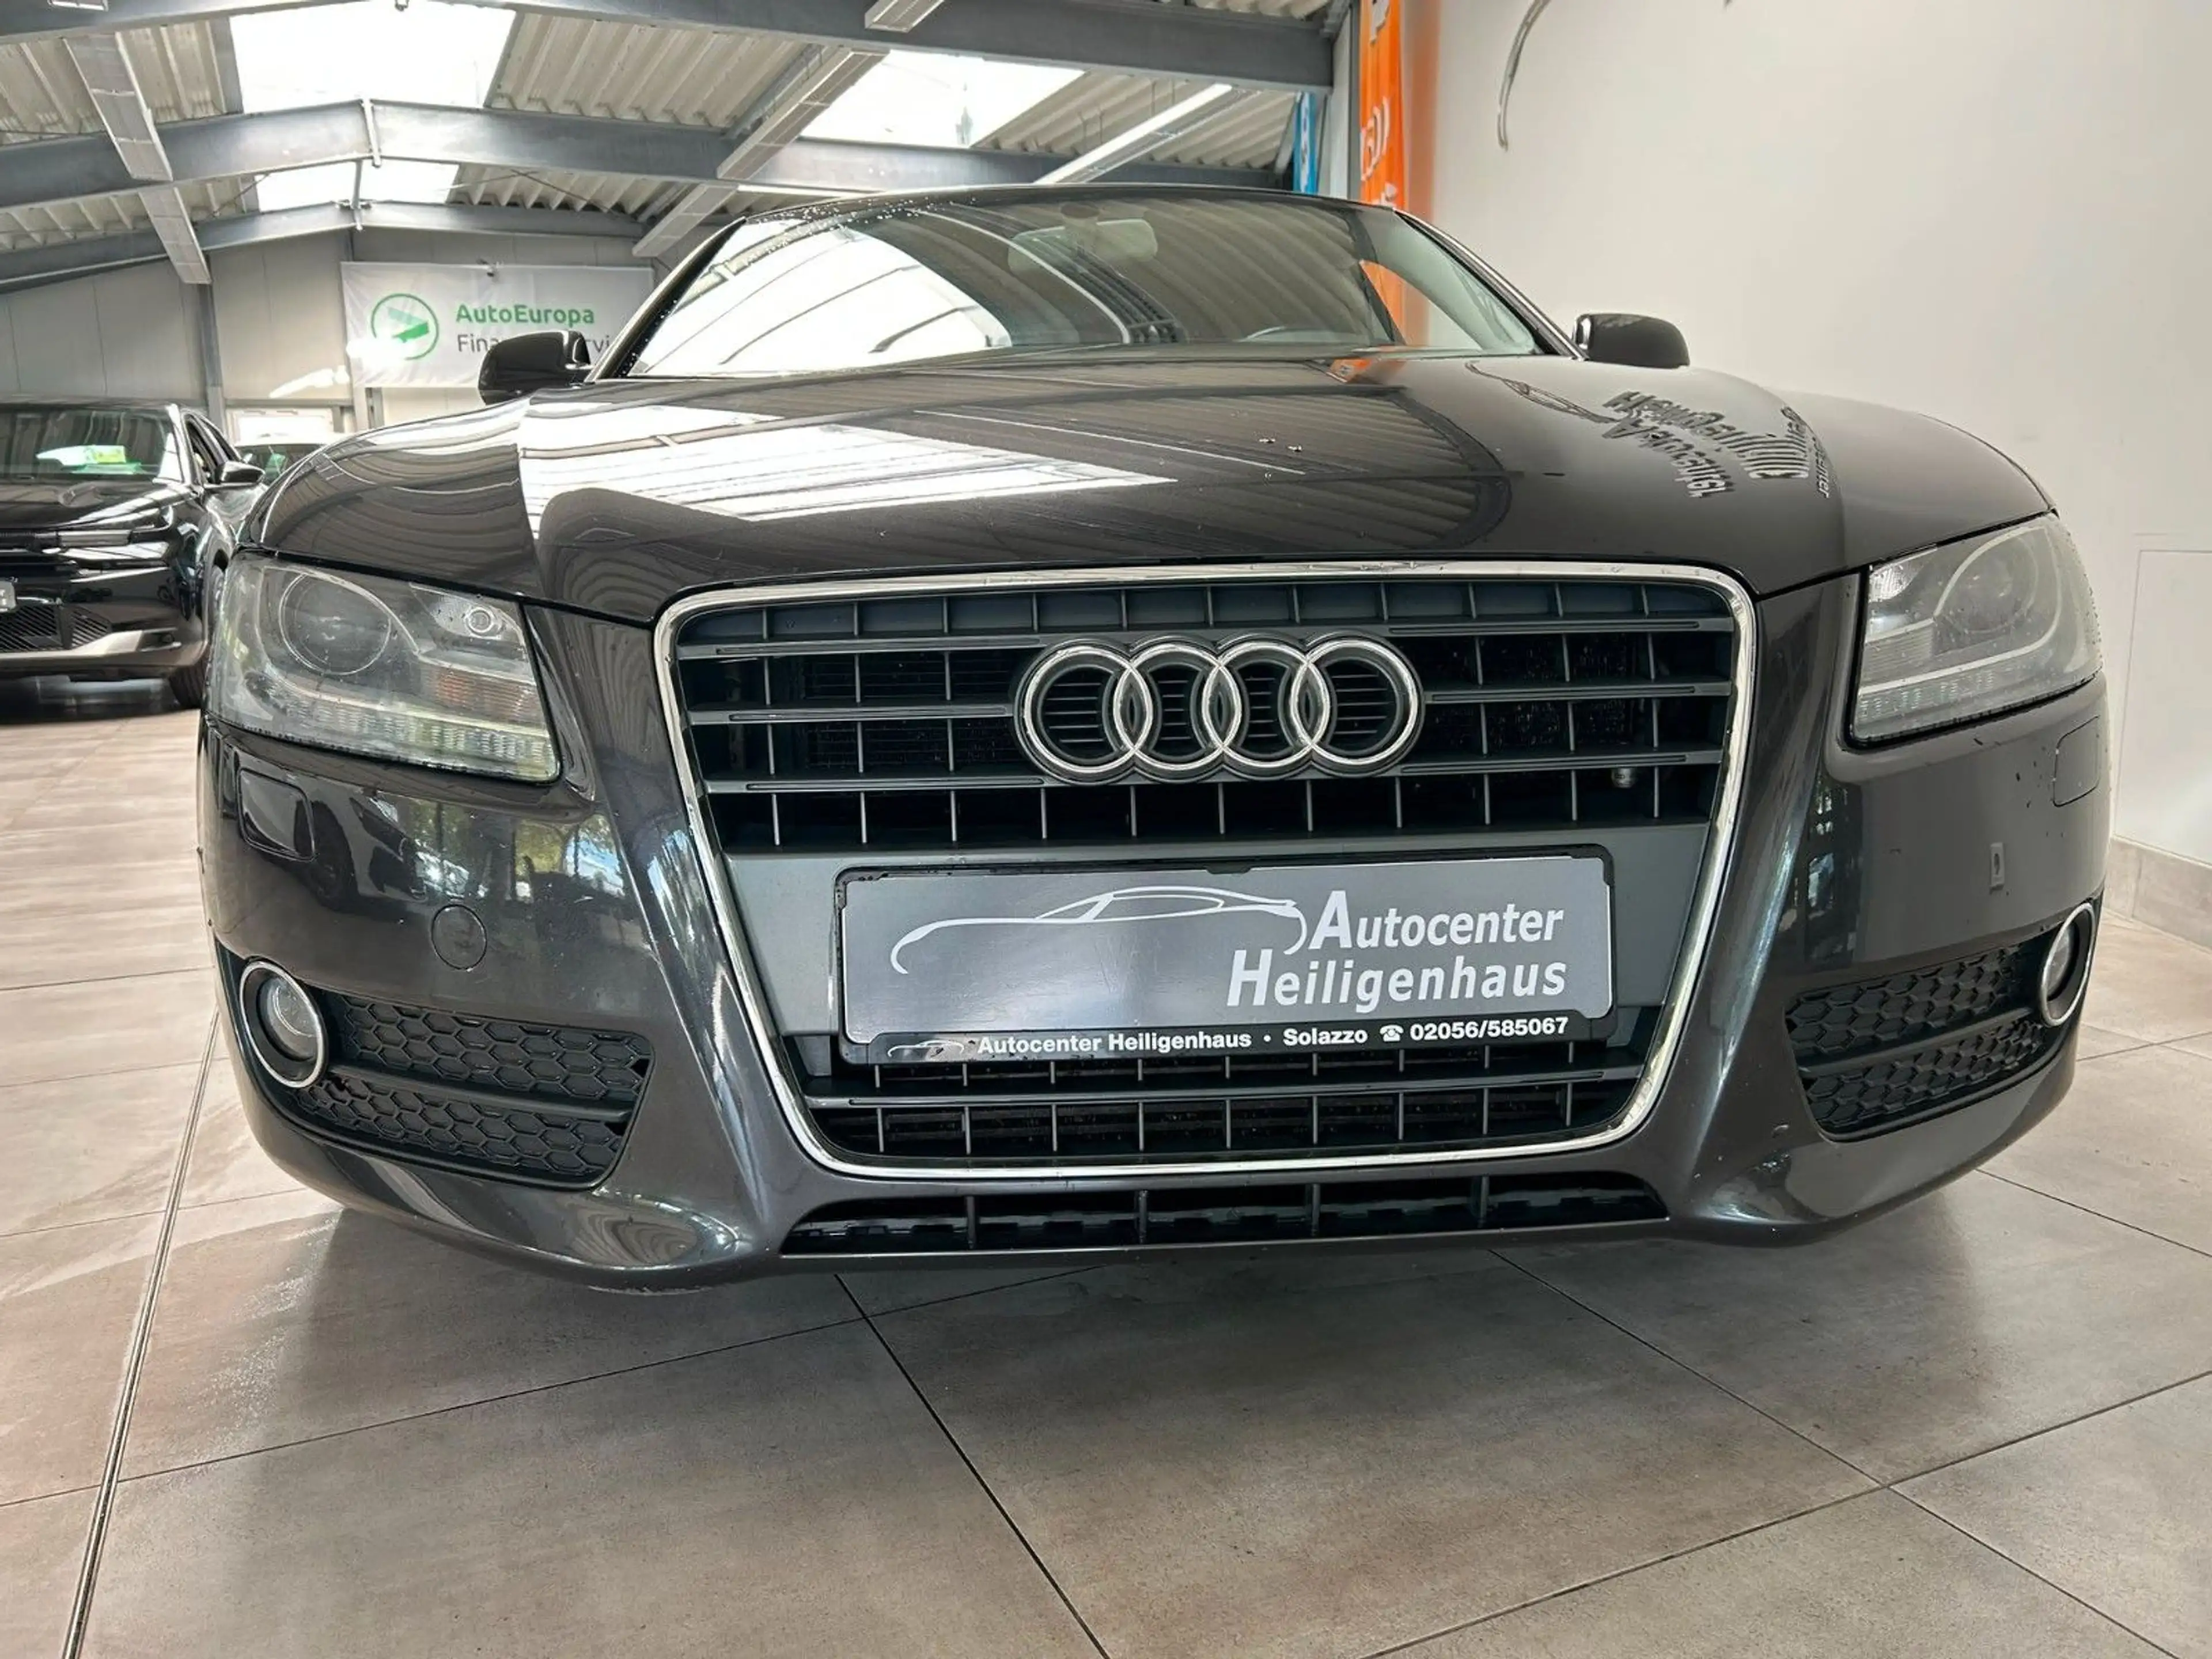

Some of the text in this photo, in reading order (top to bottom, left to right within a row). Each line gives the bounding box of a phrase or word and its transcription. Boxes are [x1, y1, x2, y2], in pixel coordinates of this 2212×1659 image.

[456, 304, 594, 328] AutoEuropa
[1308, 890, 1564, 949] Autocenter
[1226, 948, 1566, 1014] Heiligenhaus
[978, 1017, 1569, 1054] Autocenter Heiligenhaus Solazzo 02056/585067
